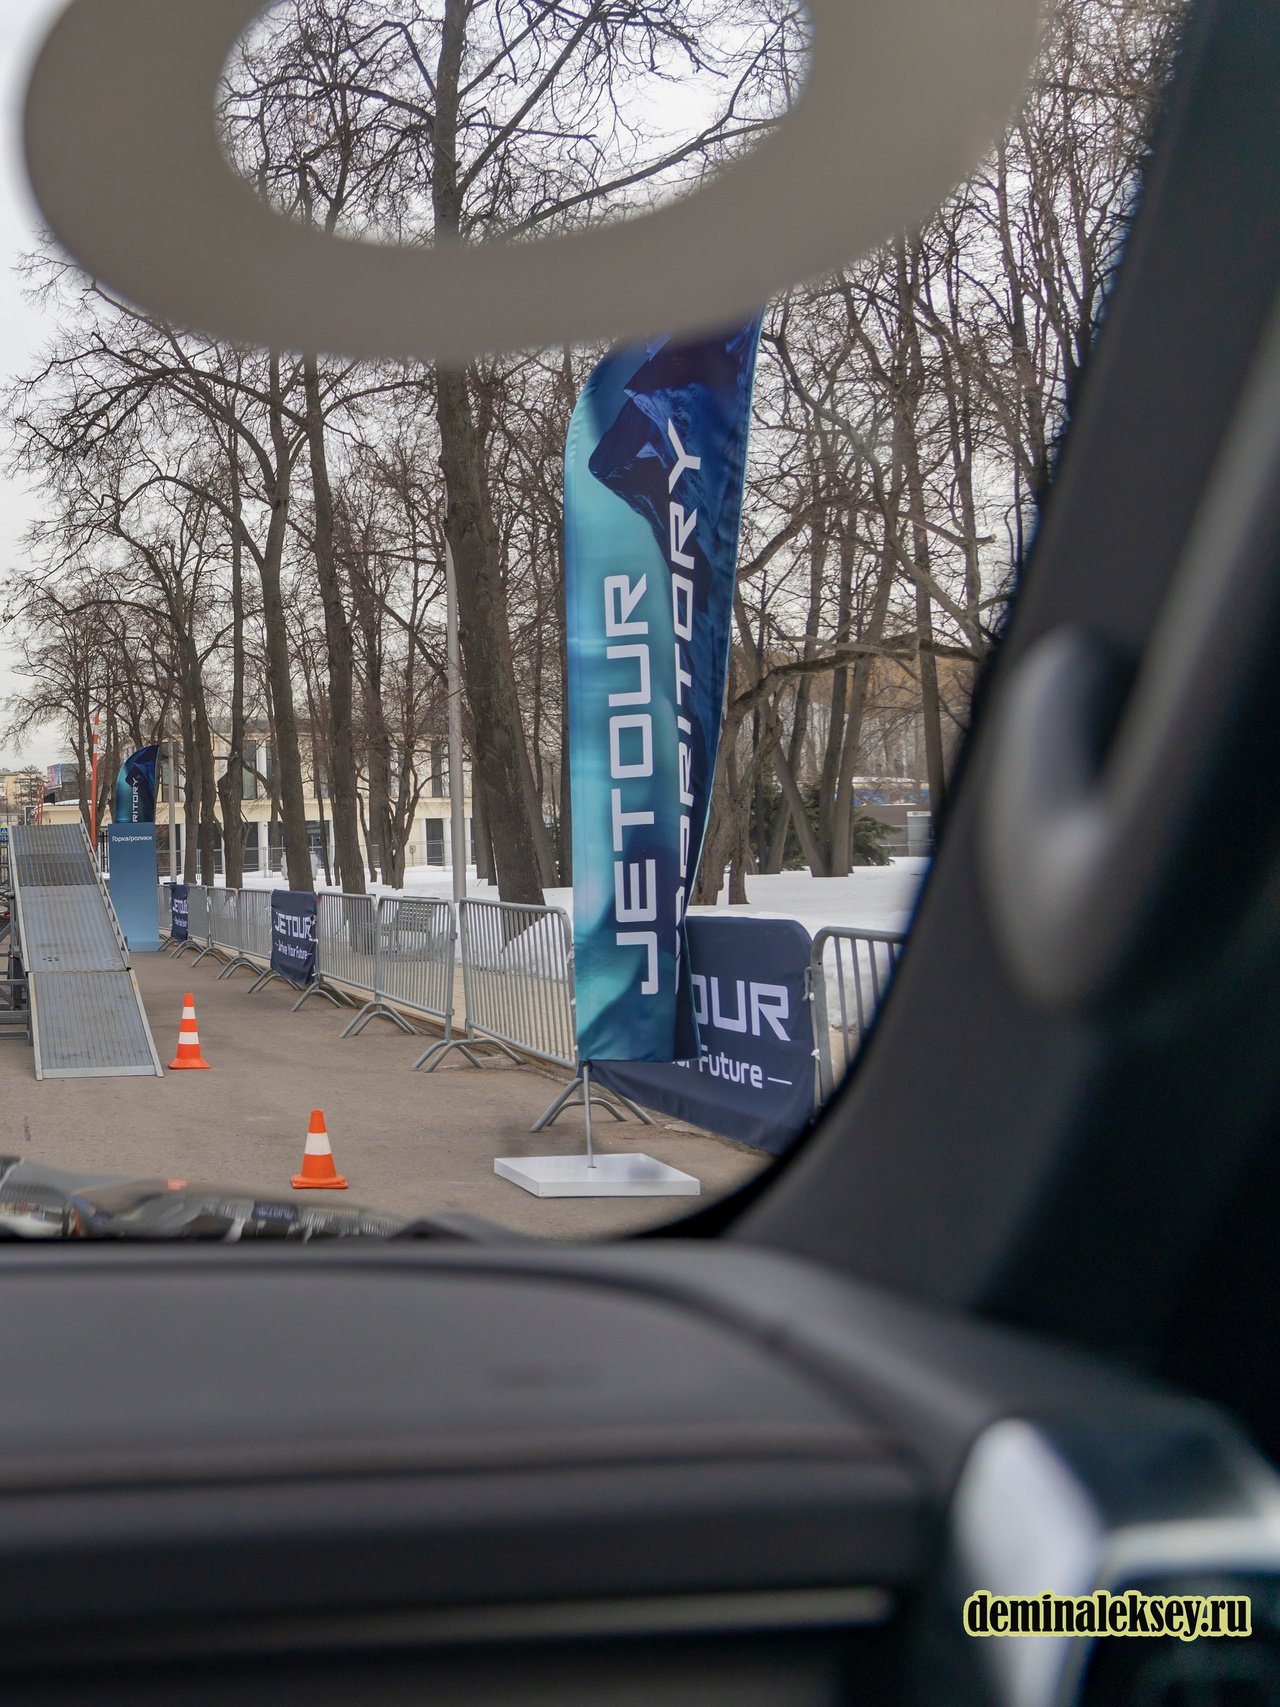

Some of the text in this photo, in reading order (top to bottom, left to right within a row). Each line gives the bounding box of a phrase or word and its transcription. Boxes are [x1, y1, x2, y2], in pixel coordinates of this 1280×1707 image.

[604, 573, 659, 995] JETOUR
[275, 912, 312, 939] JETOUR
[699, 1044, 763, 1089] Future
